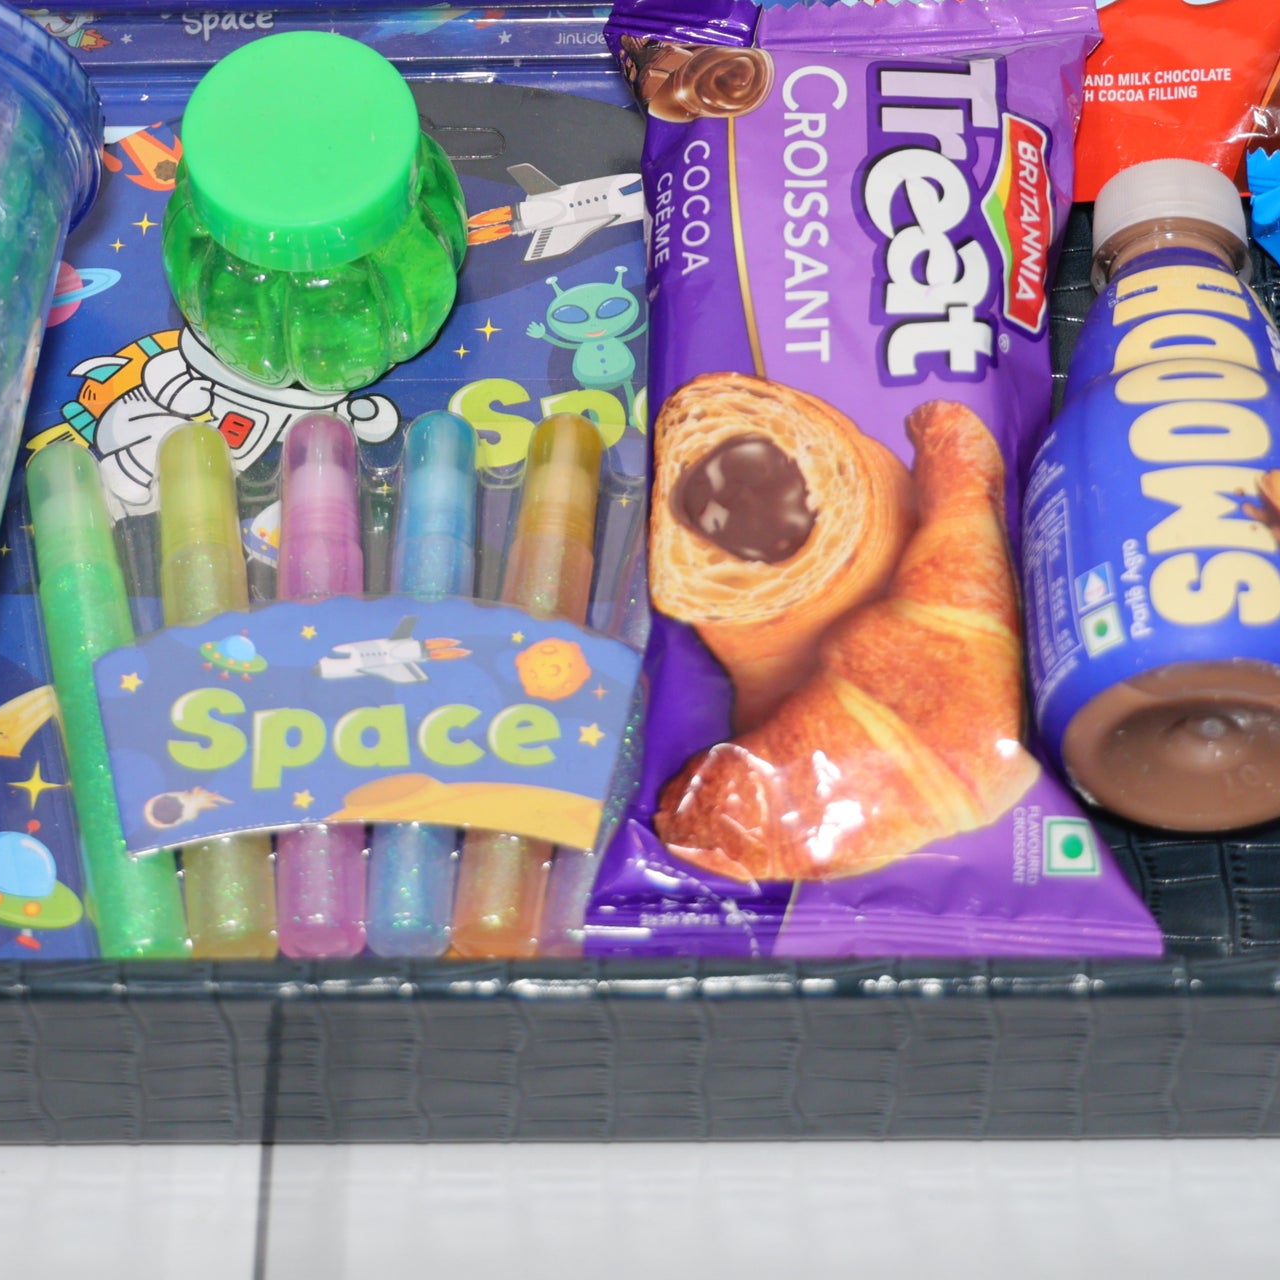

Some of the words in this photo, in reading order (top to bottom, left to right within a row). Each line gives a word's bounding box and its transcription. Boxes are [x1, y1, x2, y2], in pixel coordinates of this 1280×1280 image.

[1084, 74, 1114, 87] AND
[1118, 72, 1151, 86] MILK
[1154, 68, 1232, 84] CHOCOLATE
[1098, 89, 1144, 102] COCOA
[1148, 85, 1198, 101] FILLING
[682, 140, 711, 276] COCOA
[782, 65, 847, 362] CROISSANT
[864, 60, 999, 377] Treat
[1016, 140, 1043, 300] BRITANNIA
[1120, 538, 1147, 581] Agro
[167, 686, 563, 790] Space
